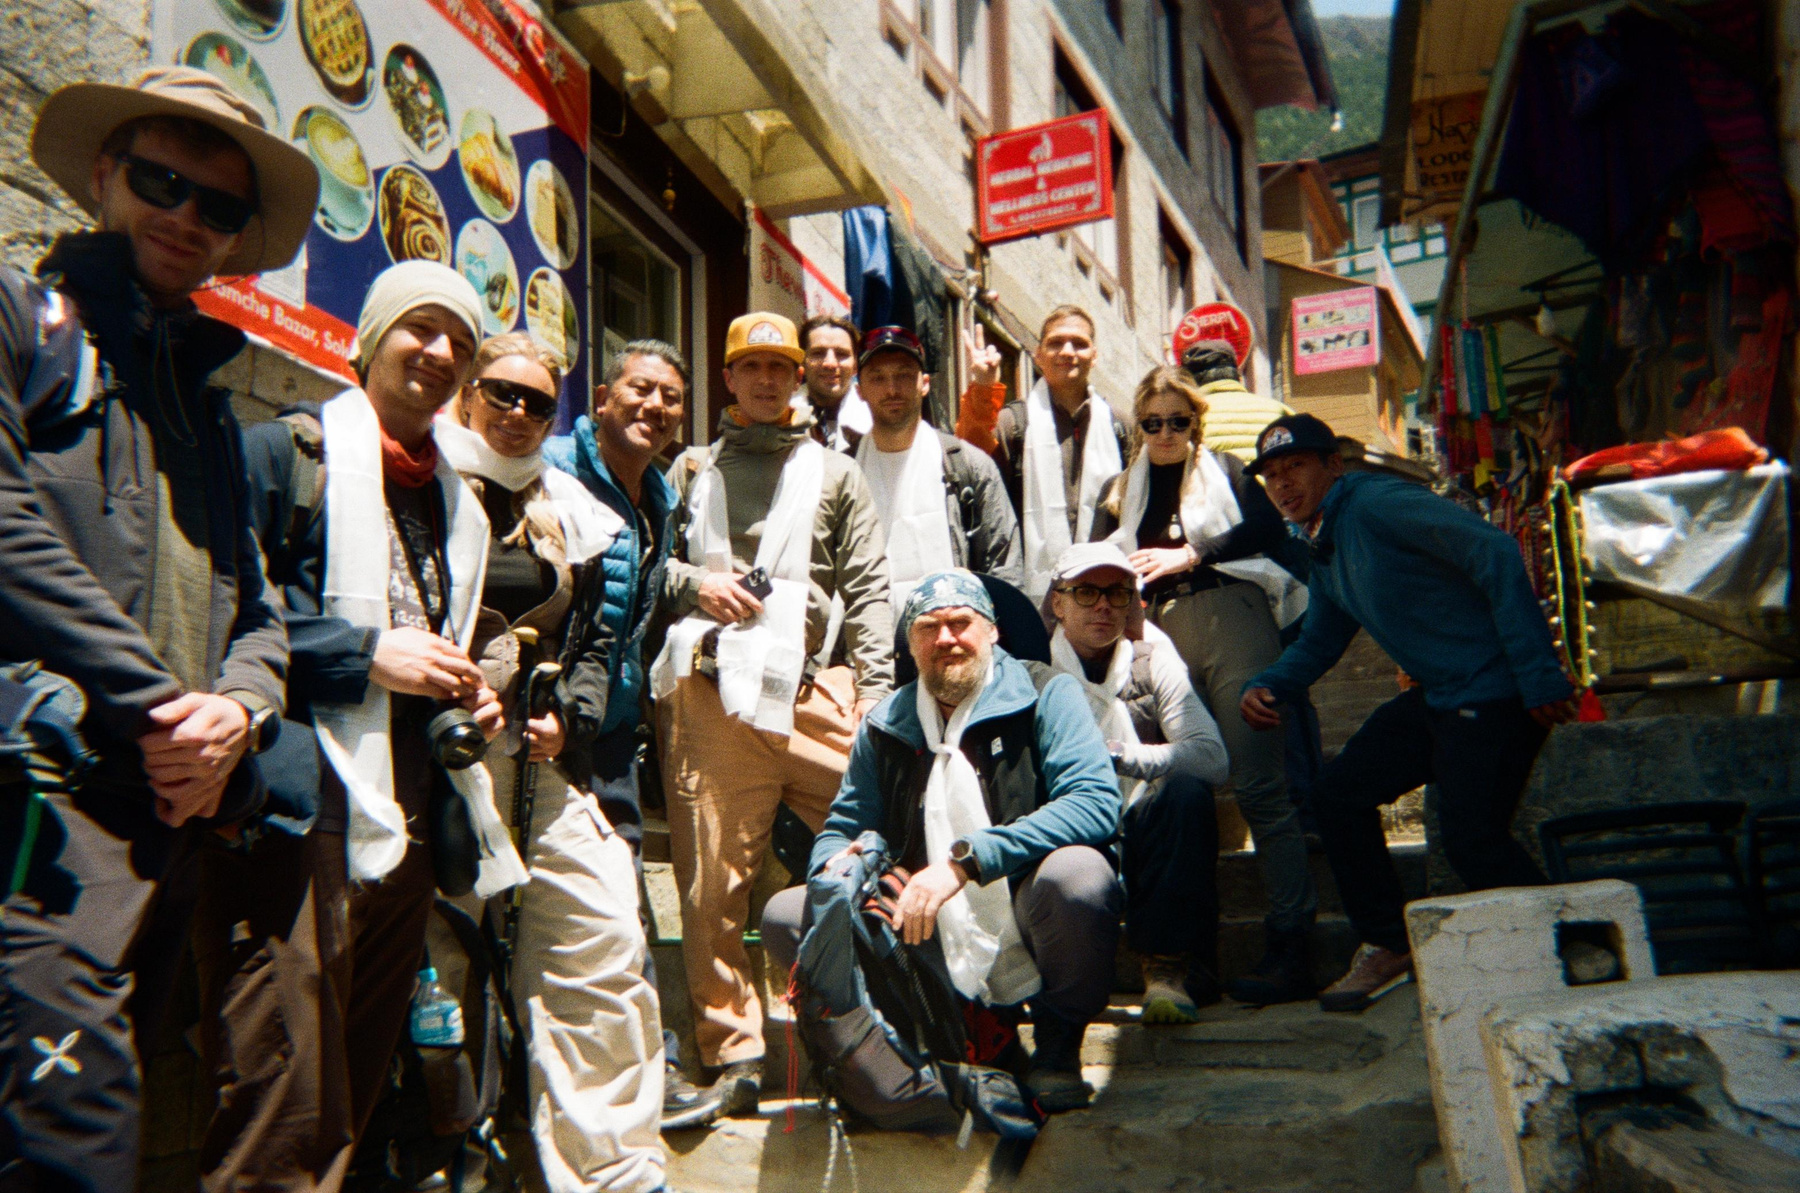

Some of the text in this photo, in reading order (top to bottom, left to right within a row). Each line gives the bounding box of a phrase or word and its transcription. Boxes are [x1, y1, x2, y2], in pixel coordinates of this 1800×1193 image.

[1036, 151, 1092, 176] MEDICINE
[989, 190, 1048, 215] WELLNESS
[1049, 180, 1095, 201] CENTER
[273, 304, 320, 348] Bazar,
